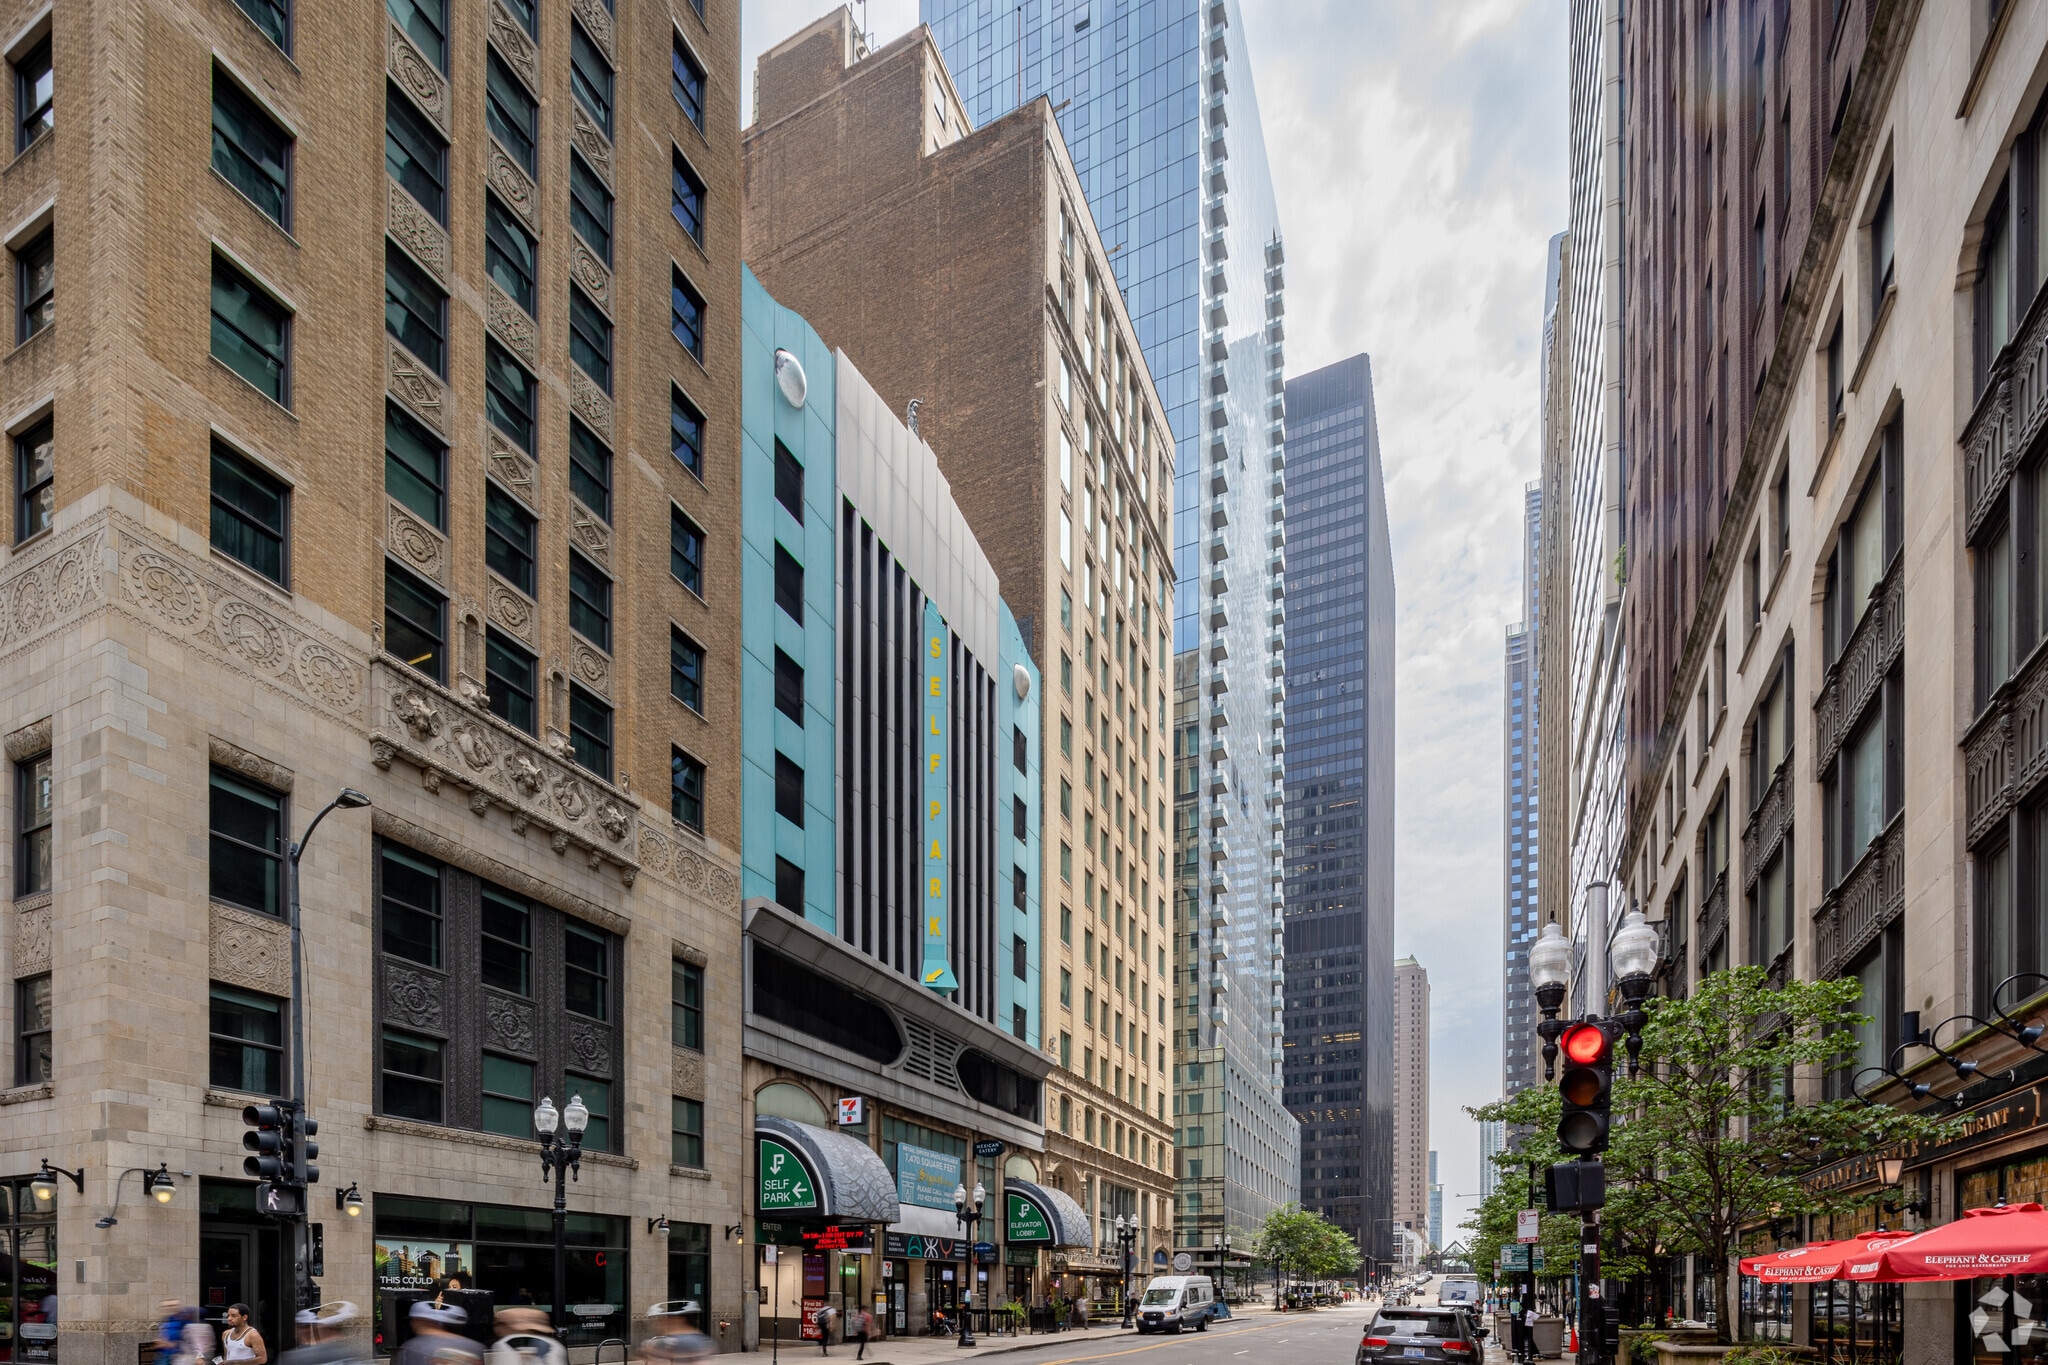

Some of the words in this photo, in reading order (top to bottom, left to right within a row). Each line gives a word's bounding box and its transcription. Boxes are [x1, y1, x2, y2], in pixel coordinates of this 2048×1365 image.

[930, 637, 942, 774] SELF
[930, 801, 942, 936] PARK
[1935, 1107, 2009, 1148] RAURANT
[921, 1157, 943, 1170] SQUARE
[944, 1163, 956, 1173] FEET
[764, 1179, 790, 1190] SELF
[917, 1185, 932, 1194] PLEASE
[933, 1188, 942, 1196] CALL
[763, 1192, 791, 1203] PARK
[762, 1222, 782, 1231] ENTER
[1011, 1221, 1041, 1229] ELEVATOR
[1925, 1255, 1977, 1264] ELEPHANT
[1978, 1254, 1989, 1263] &
[1991, 1254, 2031, 1263] CASTLE
[1764, 1266, 1804, 1276] ELEPHANT
[1804, 1265, 1813, 1276] &
[1813, 1264, 1842, 1275] CASTLE
[380, 1276, 400, 1284] THIS
[402, 1276, 434, 1284] COULD
